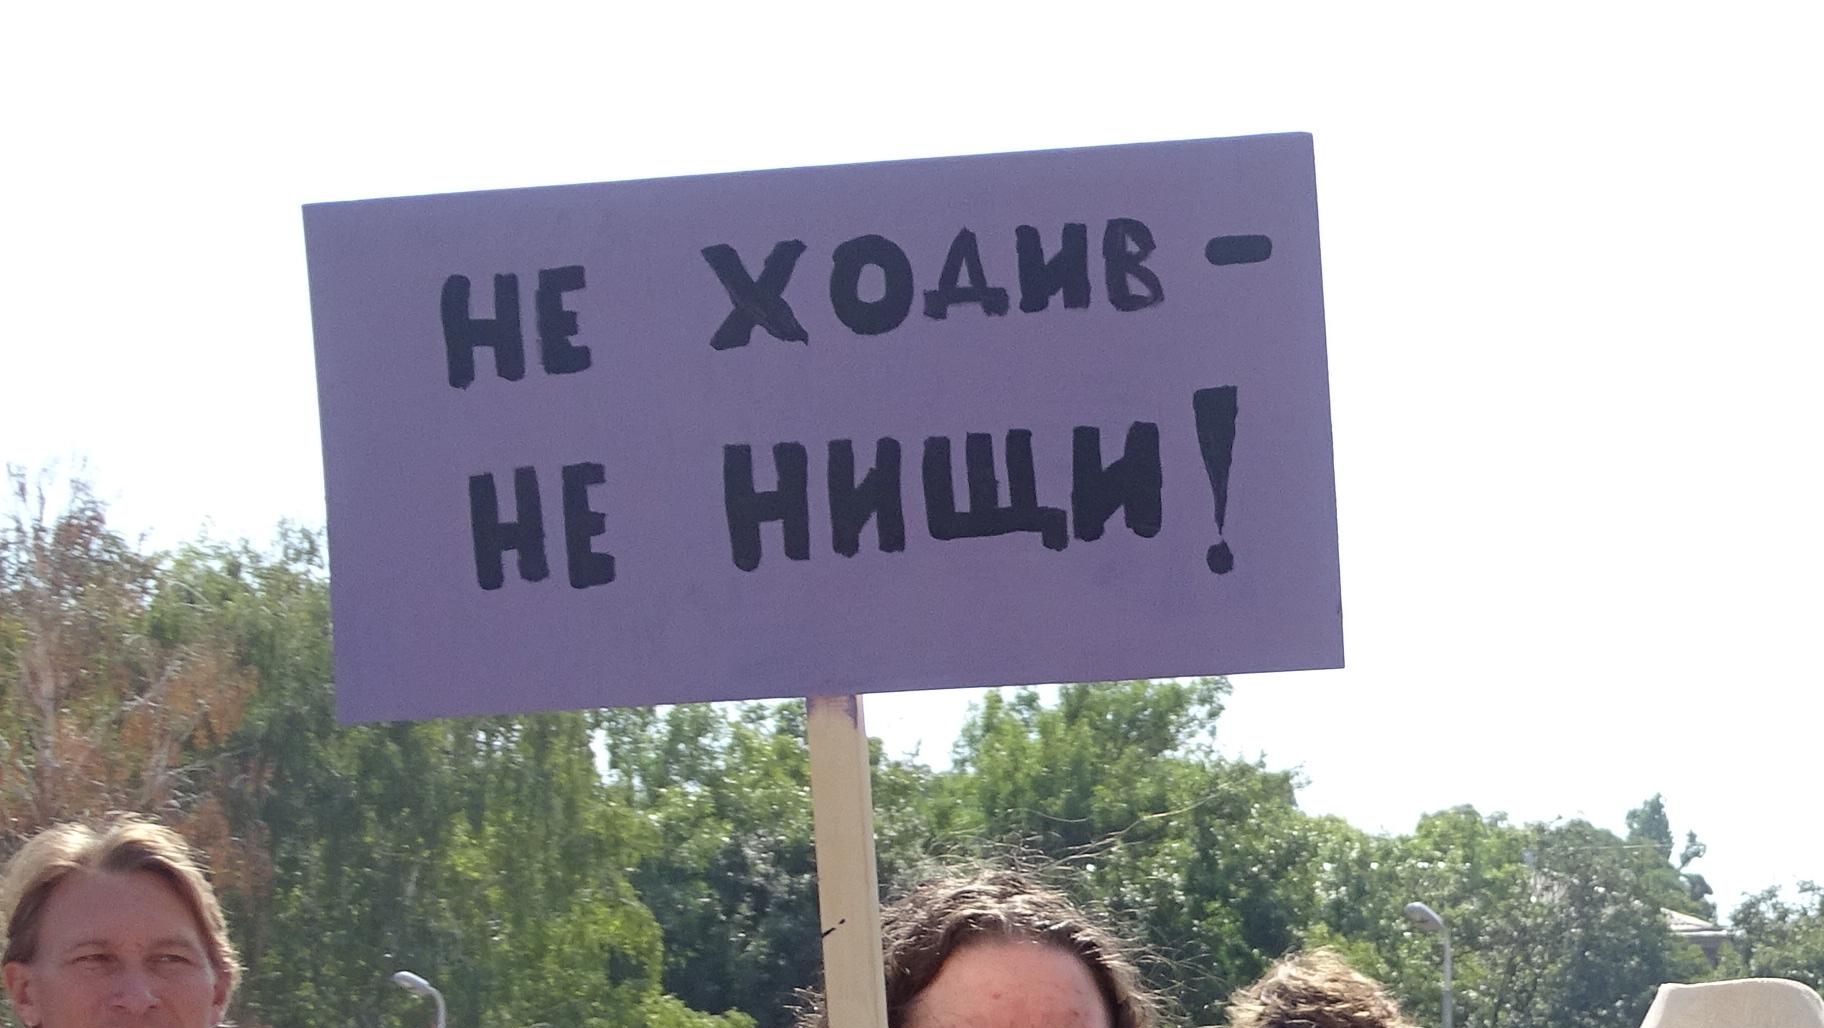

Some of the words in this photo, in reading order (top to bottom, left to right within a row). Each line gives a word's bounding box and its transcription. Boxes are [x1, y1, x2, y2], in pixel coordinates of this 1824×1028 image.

[438, 265, 593, 390] НЕ
[700, 218, 1165, 351] ХОДИВ
[468, 462, 617, 591] НЕ
[723, 385, 1239, 576] НИЩИ!
